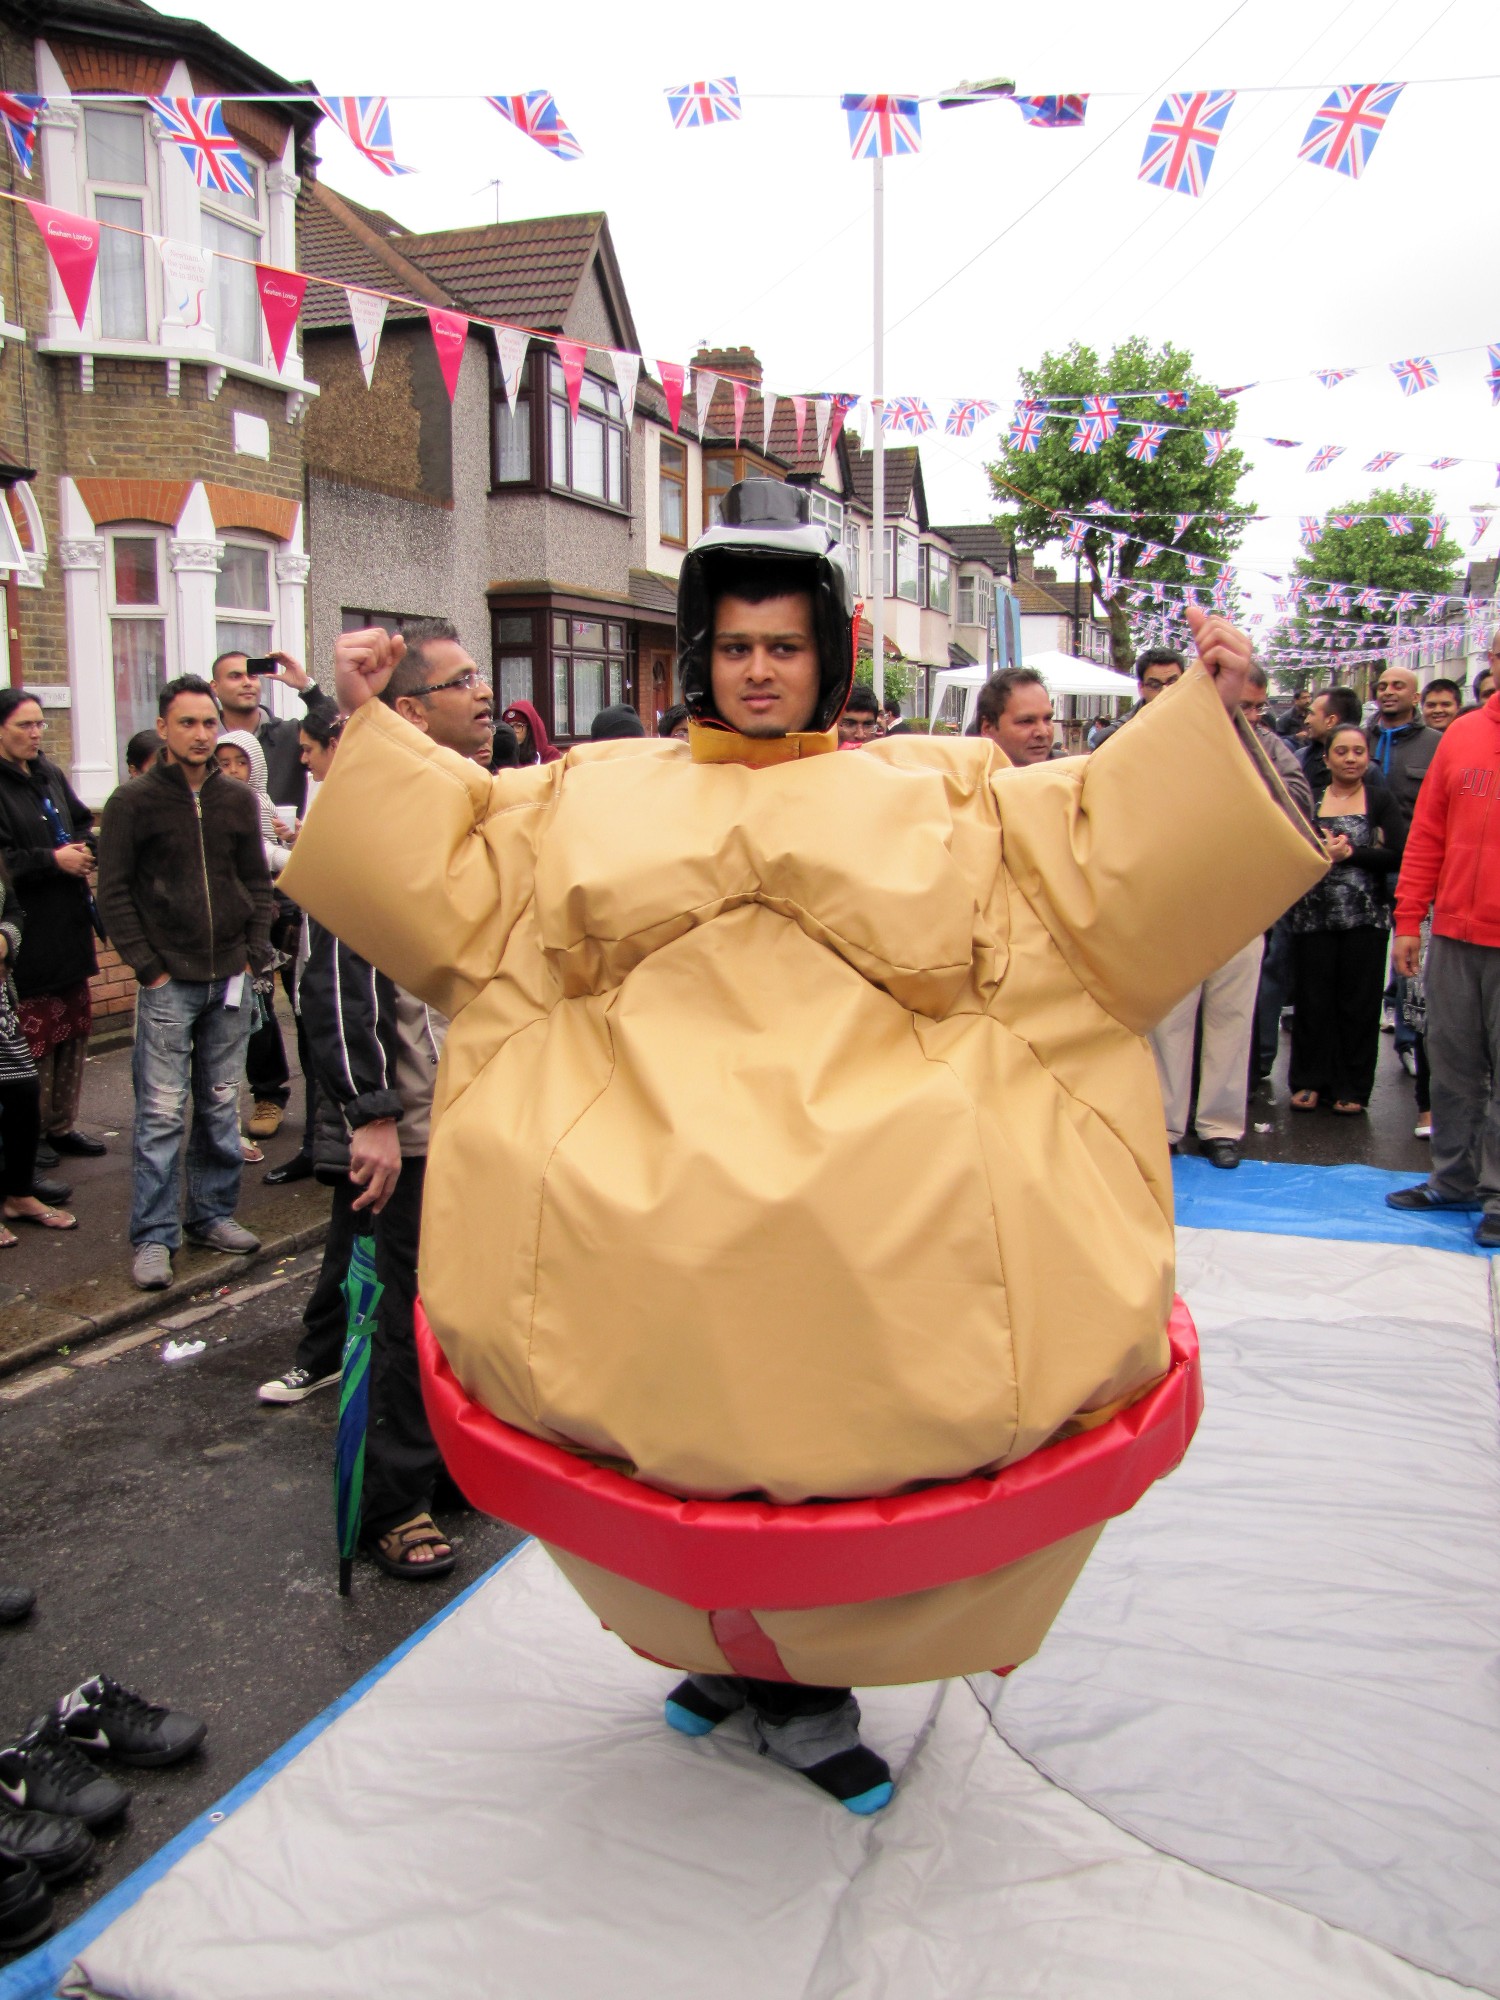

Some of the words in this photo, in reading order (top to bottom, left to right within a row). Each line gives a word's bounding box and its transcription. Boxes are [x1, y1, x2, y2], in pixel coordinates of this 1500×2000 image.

[48, 229, 72, 238] Newham
[73, 233, 93, 242] London
[264, 288, 282, 297] Newham
[283, 292, 298, 300] London
